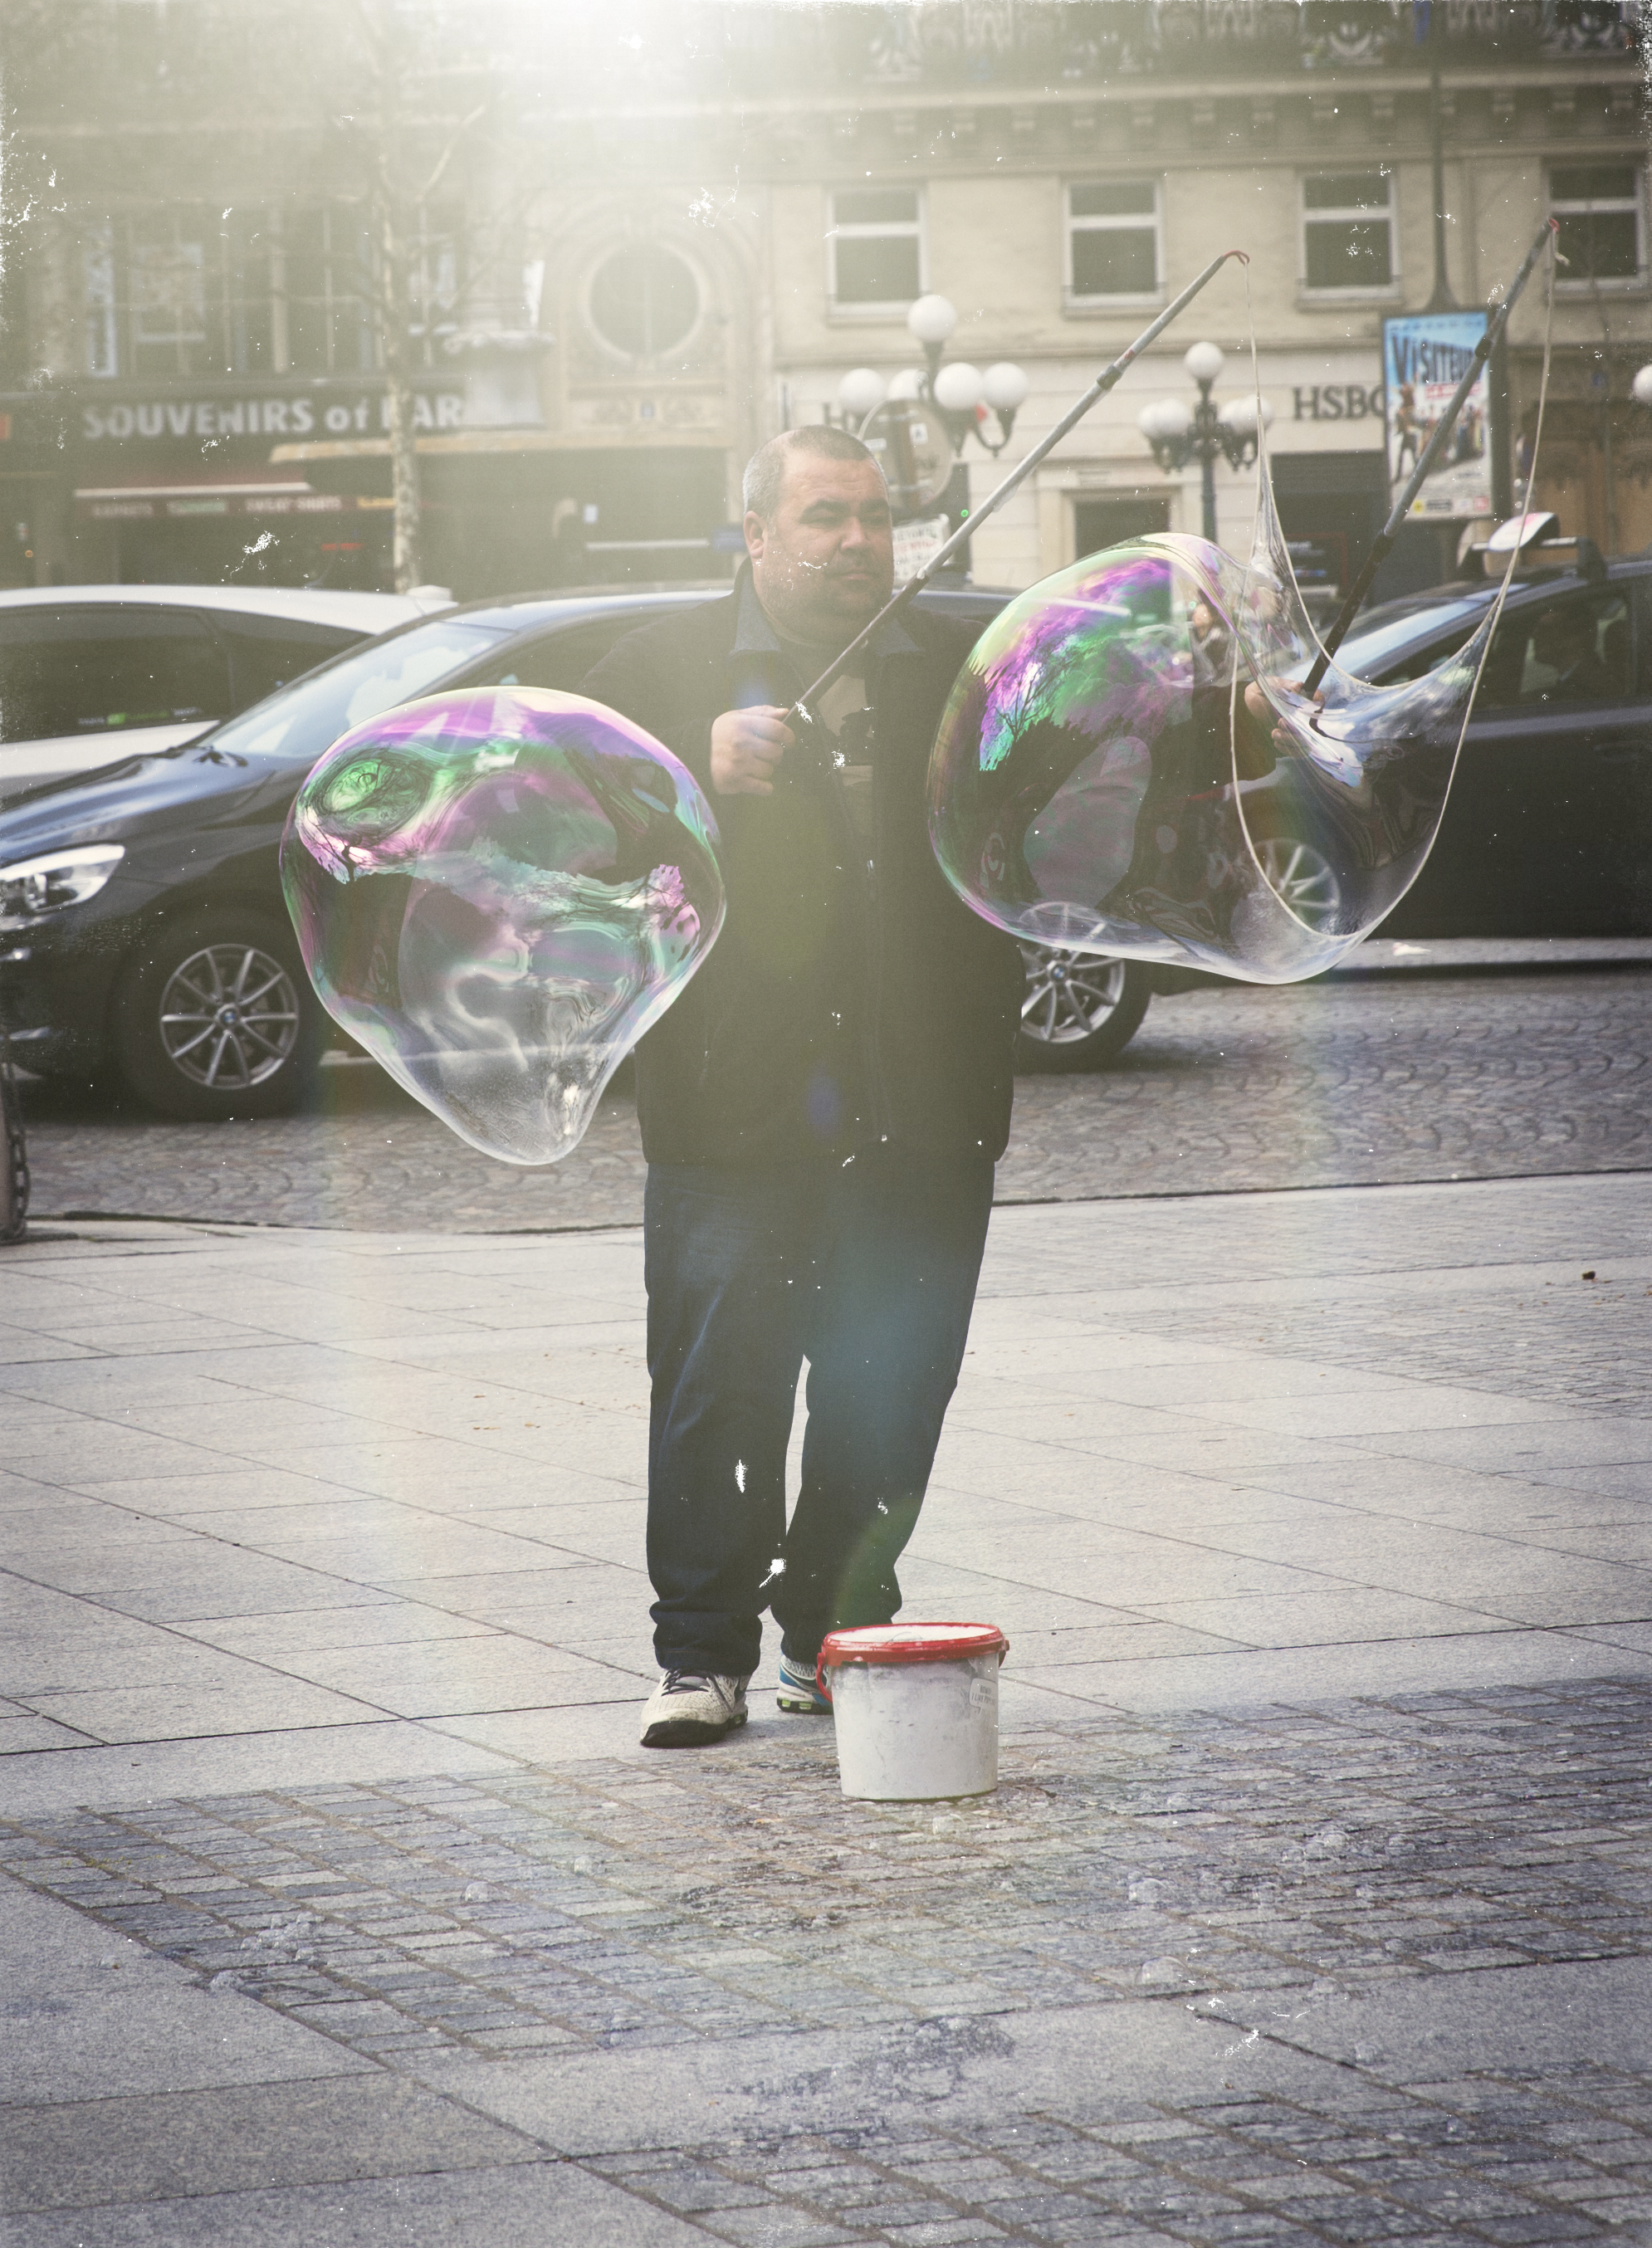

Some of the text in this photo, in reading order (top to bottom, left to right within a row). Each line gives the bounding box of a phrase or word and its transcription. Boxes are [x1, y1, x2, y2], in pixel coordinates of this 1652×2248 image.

[83, 397, 314, 439] SOUVENIRS
[325, 395, 369, 432] of
[1293, 384, 1385, 421] HSBC
